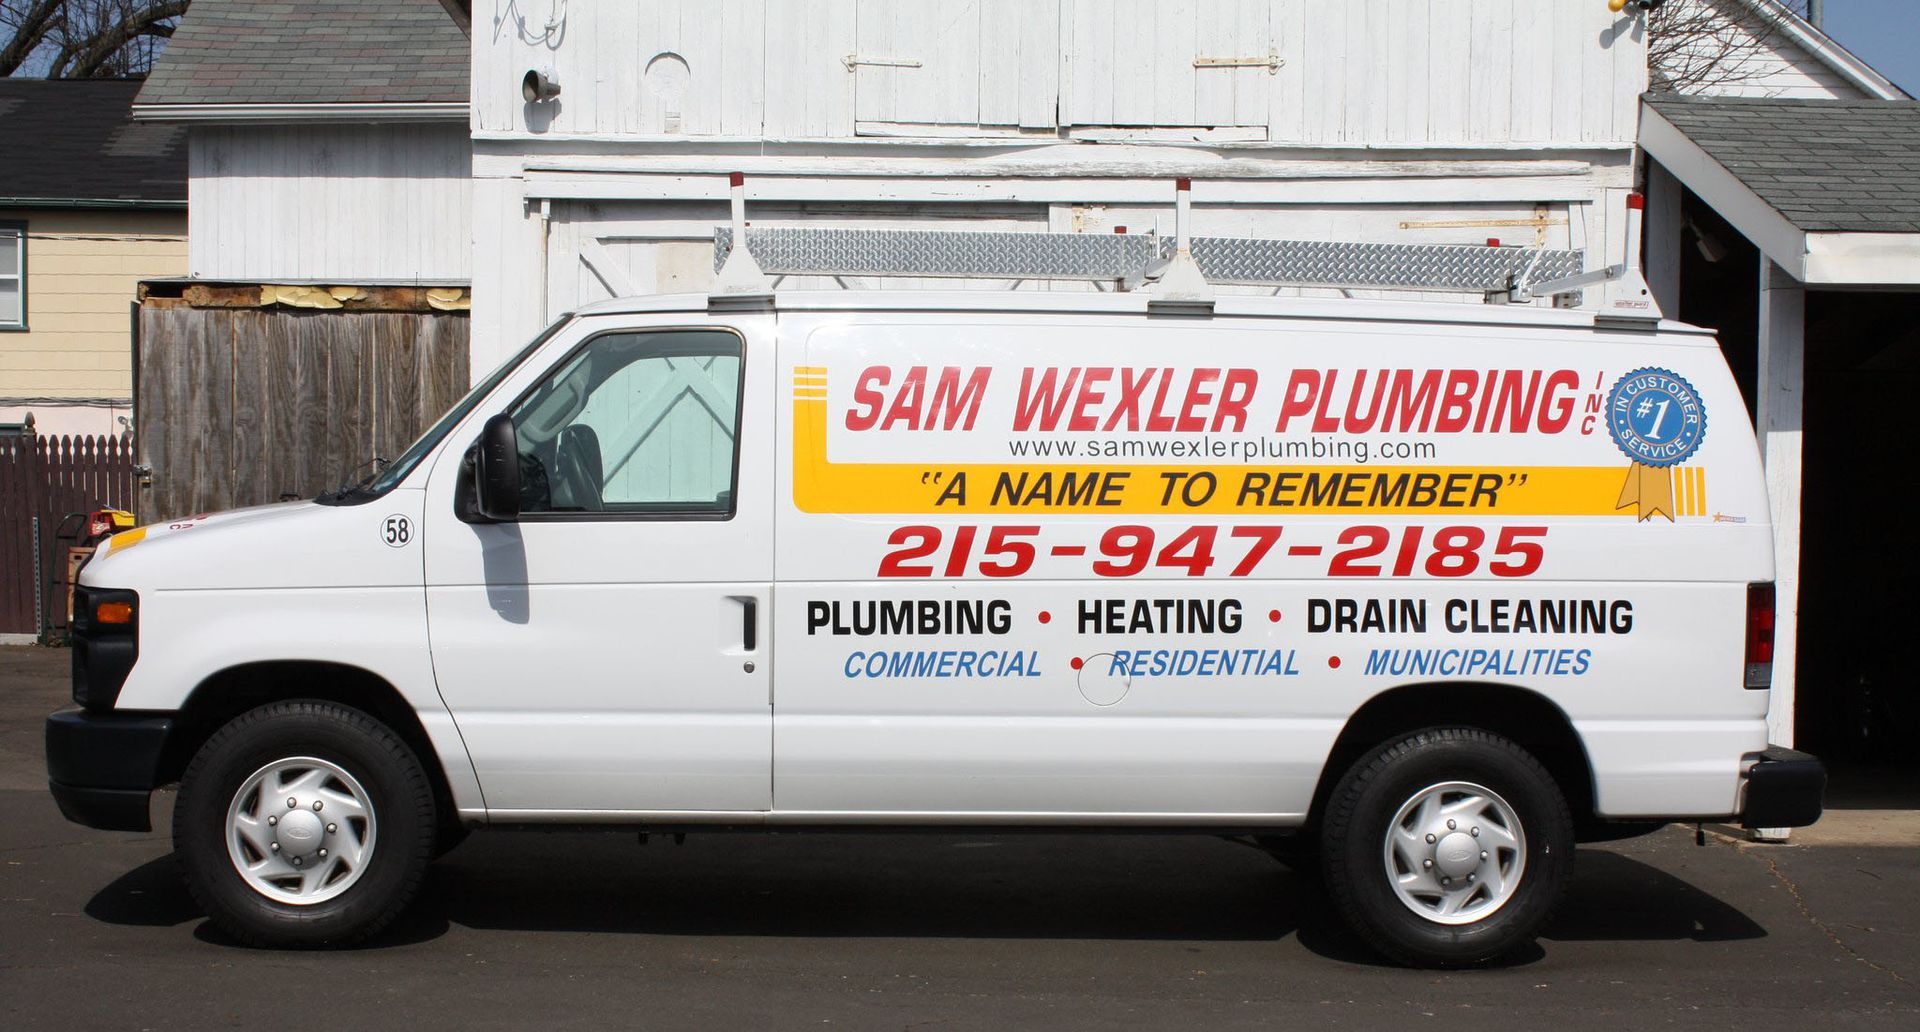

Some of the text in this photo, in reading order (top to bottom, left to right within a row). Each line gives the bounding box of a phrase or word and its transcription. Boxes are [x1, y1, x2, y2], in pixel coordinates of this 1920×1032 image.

[845, 366, 1579, 434] SAM WEXLER PLUMBING
[1581, 371, 1604, 436] INC
[1615, 376, 1698, 424] IN CUSTOMER
[1636, 397, 1670, 440] #1
[1008, 435, 1436, 464] www.samwexlerplumbing.com
[1621, 429, 1687, 457] SERVICE
[990, 472, 1131, 507] NAME
[1160, 472, 1217, 507] TO
[1236, 472, 1529, 508] REMEMBER"
[386, 518, 409, 544] 58
[876, 524, 1549, 578] 215-947-2185
[807, 598, 1634, 636] PLUMBING HEATING DRAIN CLEANING
[843, 647, 1593, 678] COMMERCIAL RESIDENTIAL MUNICIPALITIES
